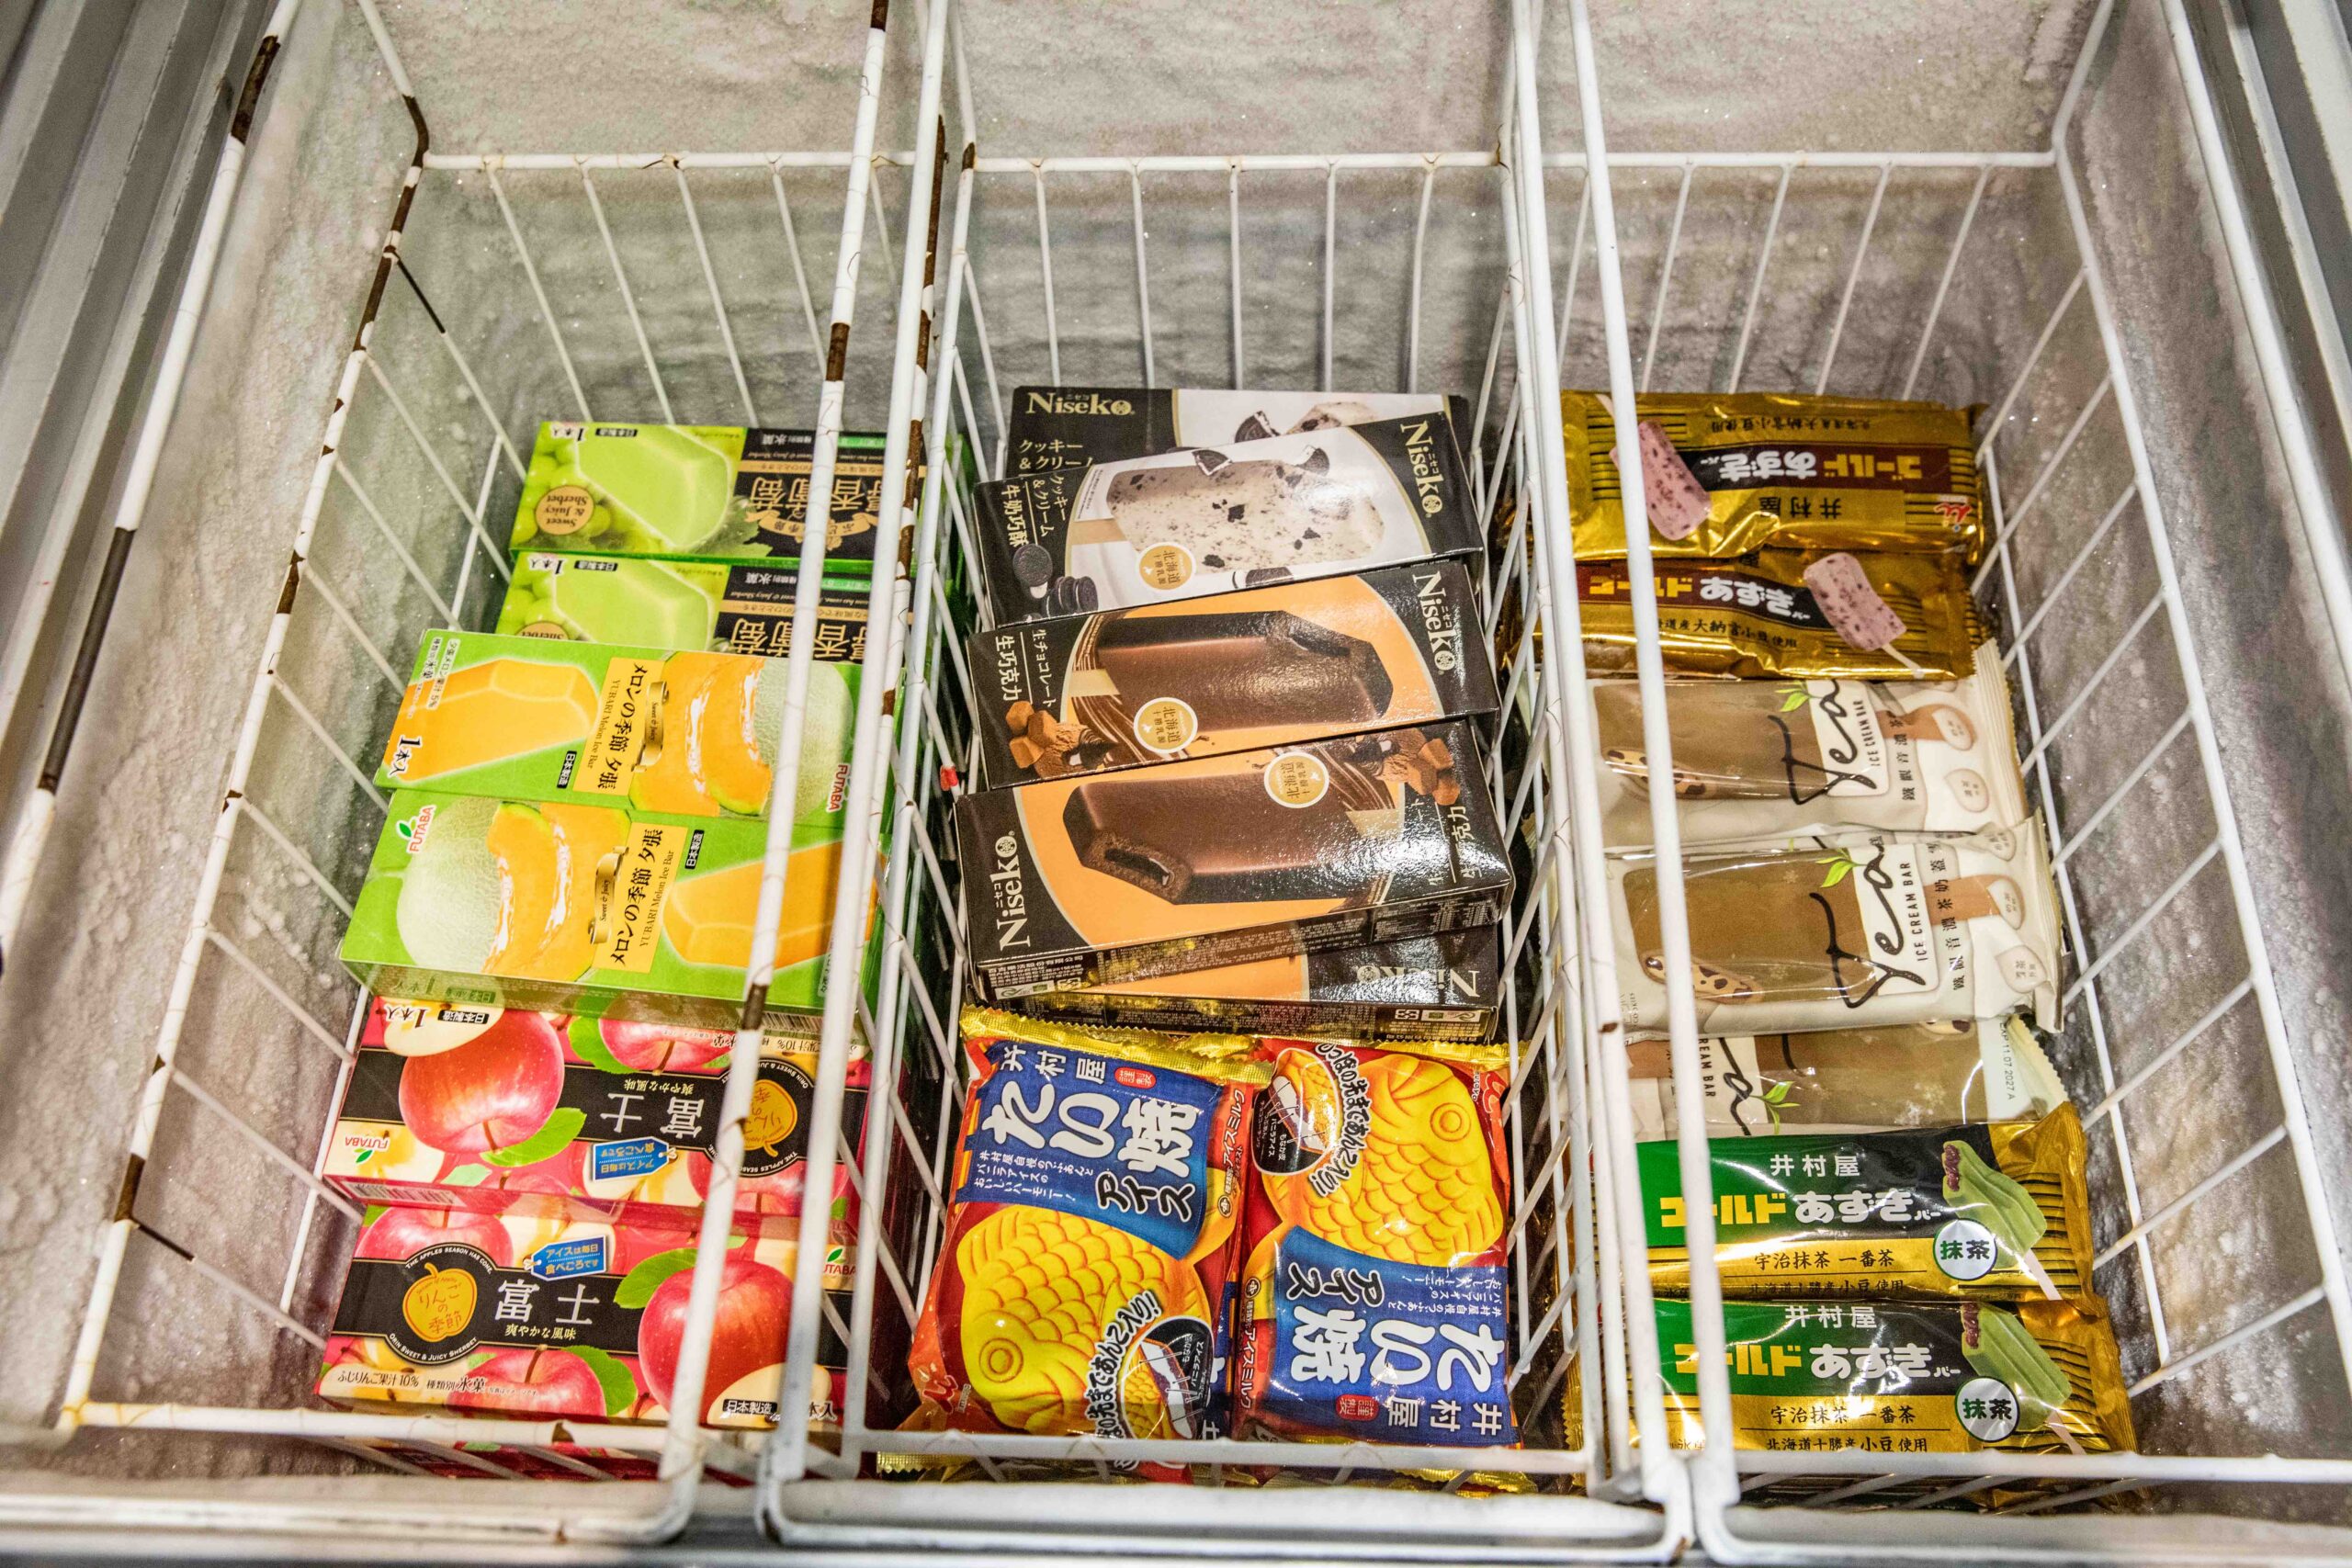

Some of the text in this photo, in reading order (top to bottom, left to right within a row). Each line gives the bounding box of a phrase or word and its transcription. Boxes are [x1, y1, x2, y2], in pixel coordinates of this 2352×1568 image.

[1025, 392, 1132, 415] Niseko
[1019, 439, 1083, 453] クッキー
[1399, 420, 1443, 516] Niseko
[543, 506, 571, 517] Juicy
[546, 494, 589, 506] Sherbet
[1049, 474, 1069, 521] クッキー
[1758, 496, 1842, 520] 井村屋
[546, 518, 577, 527] Sweet
[774, 520, 854, 536] ぶど季節
[1001, 485, 1028, 547] 牛奶巧酥
[1162, 550, 1181, 584] 北海道
[1413, 570, 1455, 671] Niseko
[995, 636, 1022, 701] 生巧克力
[1032, 629, 1056, 707] 生チョコレート
[587, 680, 620, 769] YUBARI Melon Ice Bar
[597, 664, 648, 789] メロンの季節 夕張
[1162, 707, 1181, 743] 北海道
[1852, 700, 1881, 766] ICE CREAM BAR
[389, 737, 421, 776] 1本入
[559, 752, 575, 786] 日本製造
[826, 763, 850, 812] FUTABA
[1281, 762, 1300, 798] 北海道
[406, 805, 436, 854] FUTABA
[686, 832, 703, 867] 日本製造
[601, 879, 610, 896] Juicy
[610, 829, 663, 965] メロンの季節 夕張
[639, 851, 674, 947] YUBARI Melon Ice Bar
[992, 834, 1031, 952] Niseko
[1809, 844, 1926, 1009] Tea
[1900, 862, 1928, 962] ICE CREAM BAR
[383, 1004, 428, 1029] 1本入
[440, 1010, 486, 1024] 日本製造
[776, 1065, 795, 1077] SWEET
[792, 1072, 809, 1089] ORIN
[1001, 1044, 1107, 1085] 井村屋
[1699, 1039, 1716, 1097] REAM BAR
[624, 1079, 695, 1095] 爽やかな風味
[600, 1093, 705, 1139] 富士
[981, 1080, 1199, 1178] たい焼
[1223, 1089, 1245, 1167] アイスミルク
[345, 1135, 389, 1150] FUTABA
[1268, 1118, 1276, 1157] バニラアイス
[600, 1159, 654, 1173] アイスは毎日
[760, 1151, 797, 1172] THE APPLES
[977, 1164, 1049, 1183] バニラアイスの
[979, 1150, 1094, 1177] 井村屋自慢のつぶあんと
[1770, 1154, 1860, 1179] 井村屋
[1096, 1171, 1196, 1222] アイス
[405, 1258, 419, 1269] THE
[419, 1247, 443, 1260] APPLES
[469, 1251, 481, 1261] HAS
[546, 1243, 599, 1259] アイスは毎日
[1754, 1248, 1895, 1272] 宇治抹茶 一番茶
[1939, 1239, 1992, 1261] 抹茶
[420, 1282, 462, 1309] りんご
[1286, 1263, 1385, 1307] アイス
[1430, 1291, 1502, 1304] バニラアイスの
[494, 1279, 601, 1326] 富士
[1387, 1301, 1502, 1317] 井村屋自慢のつぶあんと
[1784, 1306, 1878, 1329] 井村屋
[429, 1312, 462, 1334] 季節
[504, 1323, 577, 1341] 爽やかな風味
[389, 1333, 401, 1348] ORIN
[401, 1346, 421, 1359] SWEET
[428, 1352, 447, 1360] JUICY
[448, 1337, 478, 1357] SHERBET
[1291, 1306, 1505, 1393] たい焼
[338, 1371, 419, 1388] ふじりんご果汁 10%
[1191, 1341, 1204, 1387] バニラアイス
[1241, 1327, 1256, 1409] アイスミルク
[728, 1401, 772, 1414] 日本製造
[1388, 1396, 1502, 1436] 井村屋
[1770, 1404, 1917, 1425] 宇治抹茶 一番茶
[1962, 1398, 2015, 1421] 抹茶
